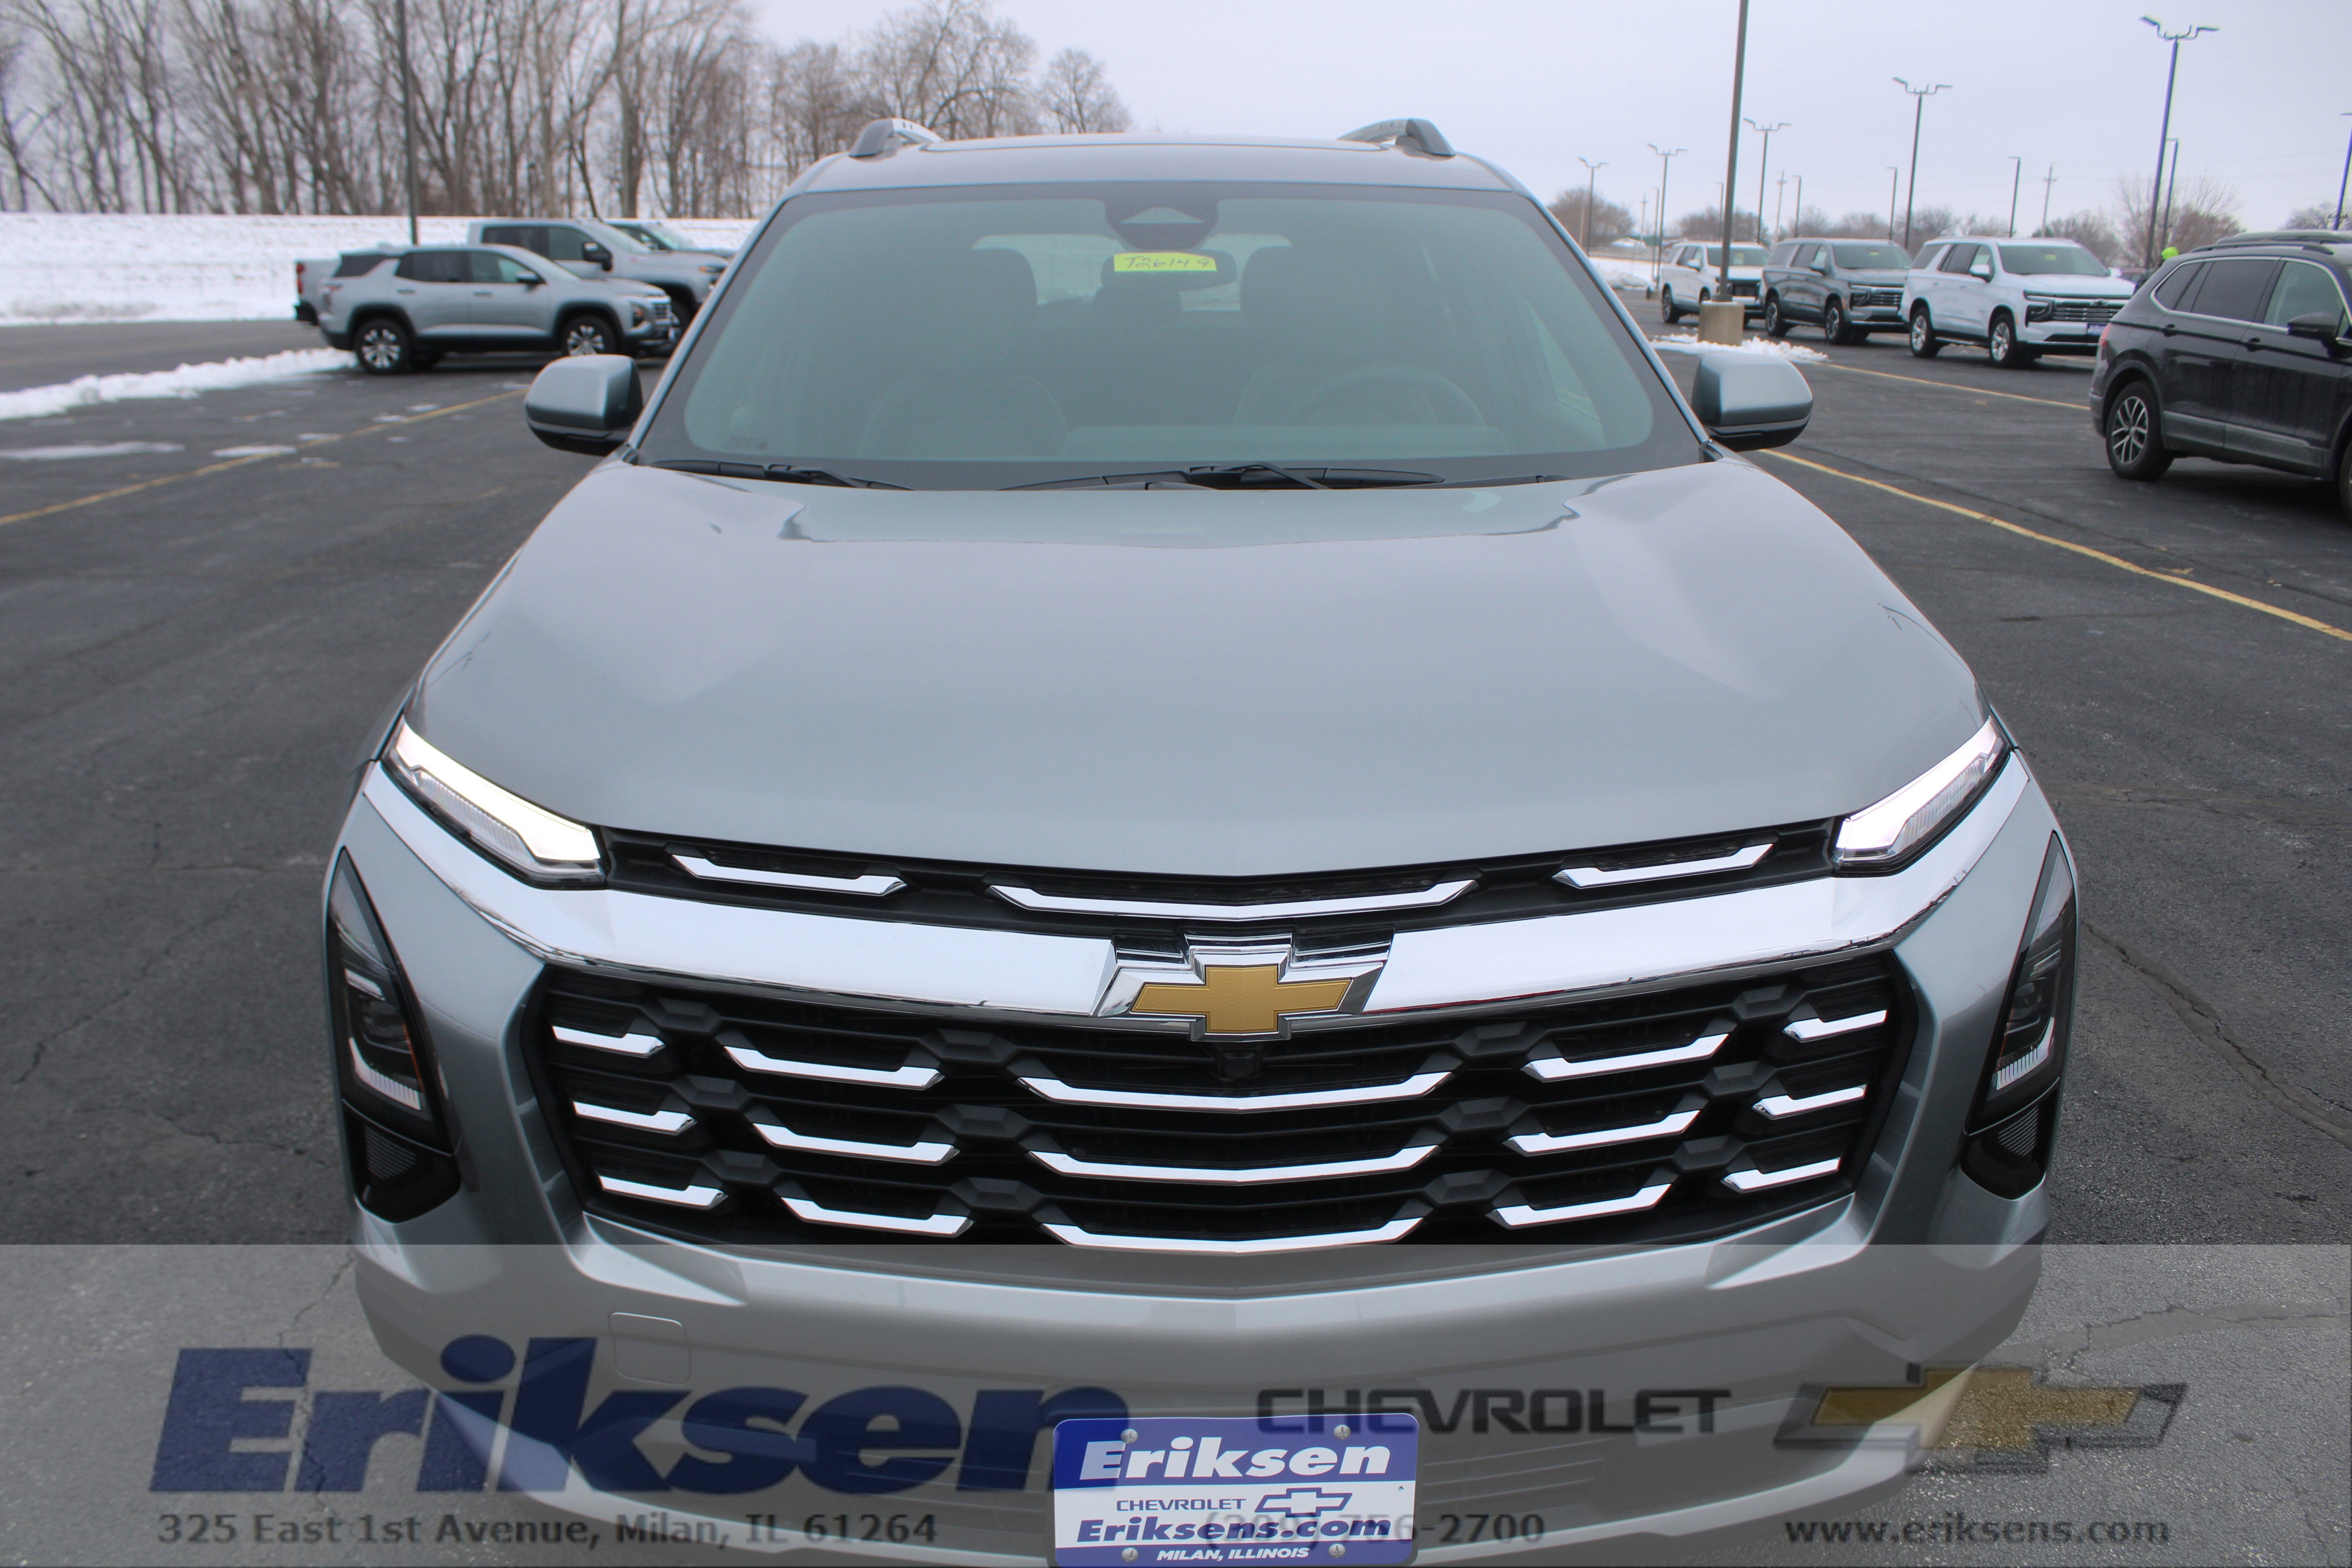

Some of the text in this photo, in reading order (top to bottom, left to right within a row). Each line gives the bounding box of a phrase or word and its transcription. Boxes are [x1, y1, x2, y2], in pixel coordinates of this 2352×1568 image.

[1079, 1437, 1390, 1480] Eriksen
[1116, 1499, 1246, 1511] CHEVROLET
[1077, 1516, 1391, 1543] Eriksens.com
[1157, 1547, 1309, 1561] MILAN, ILLINOIS
